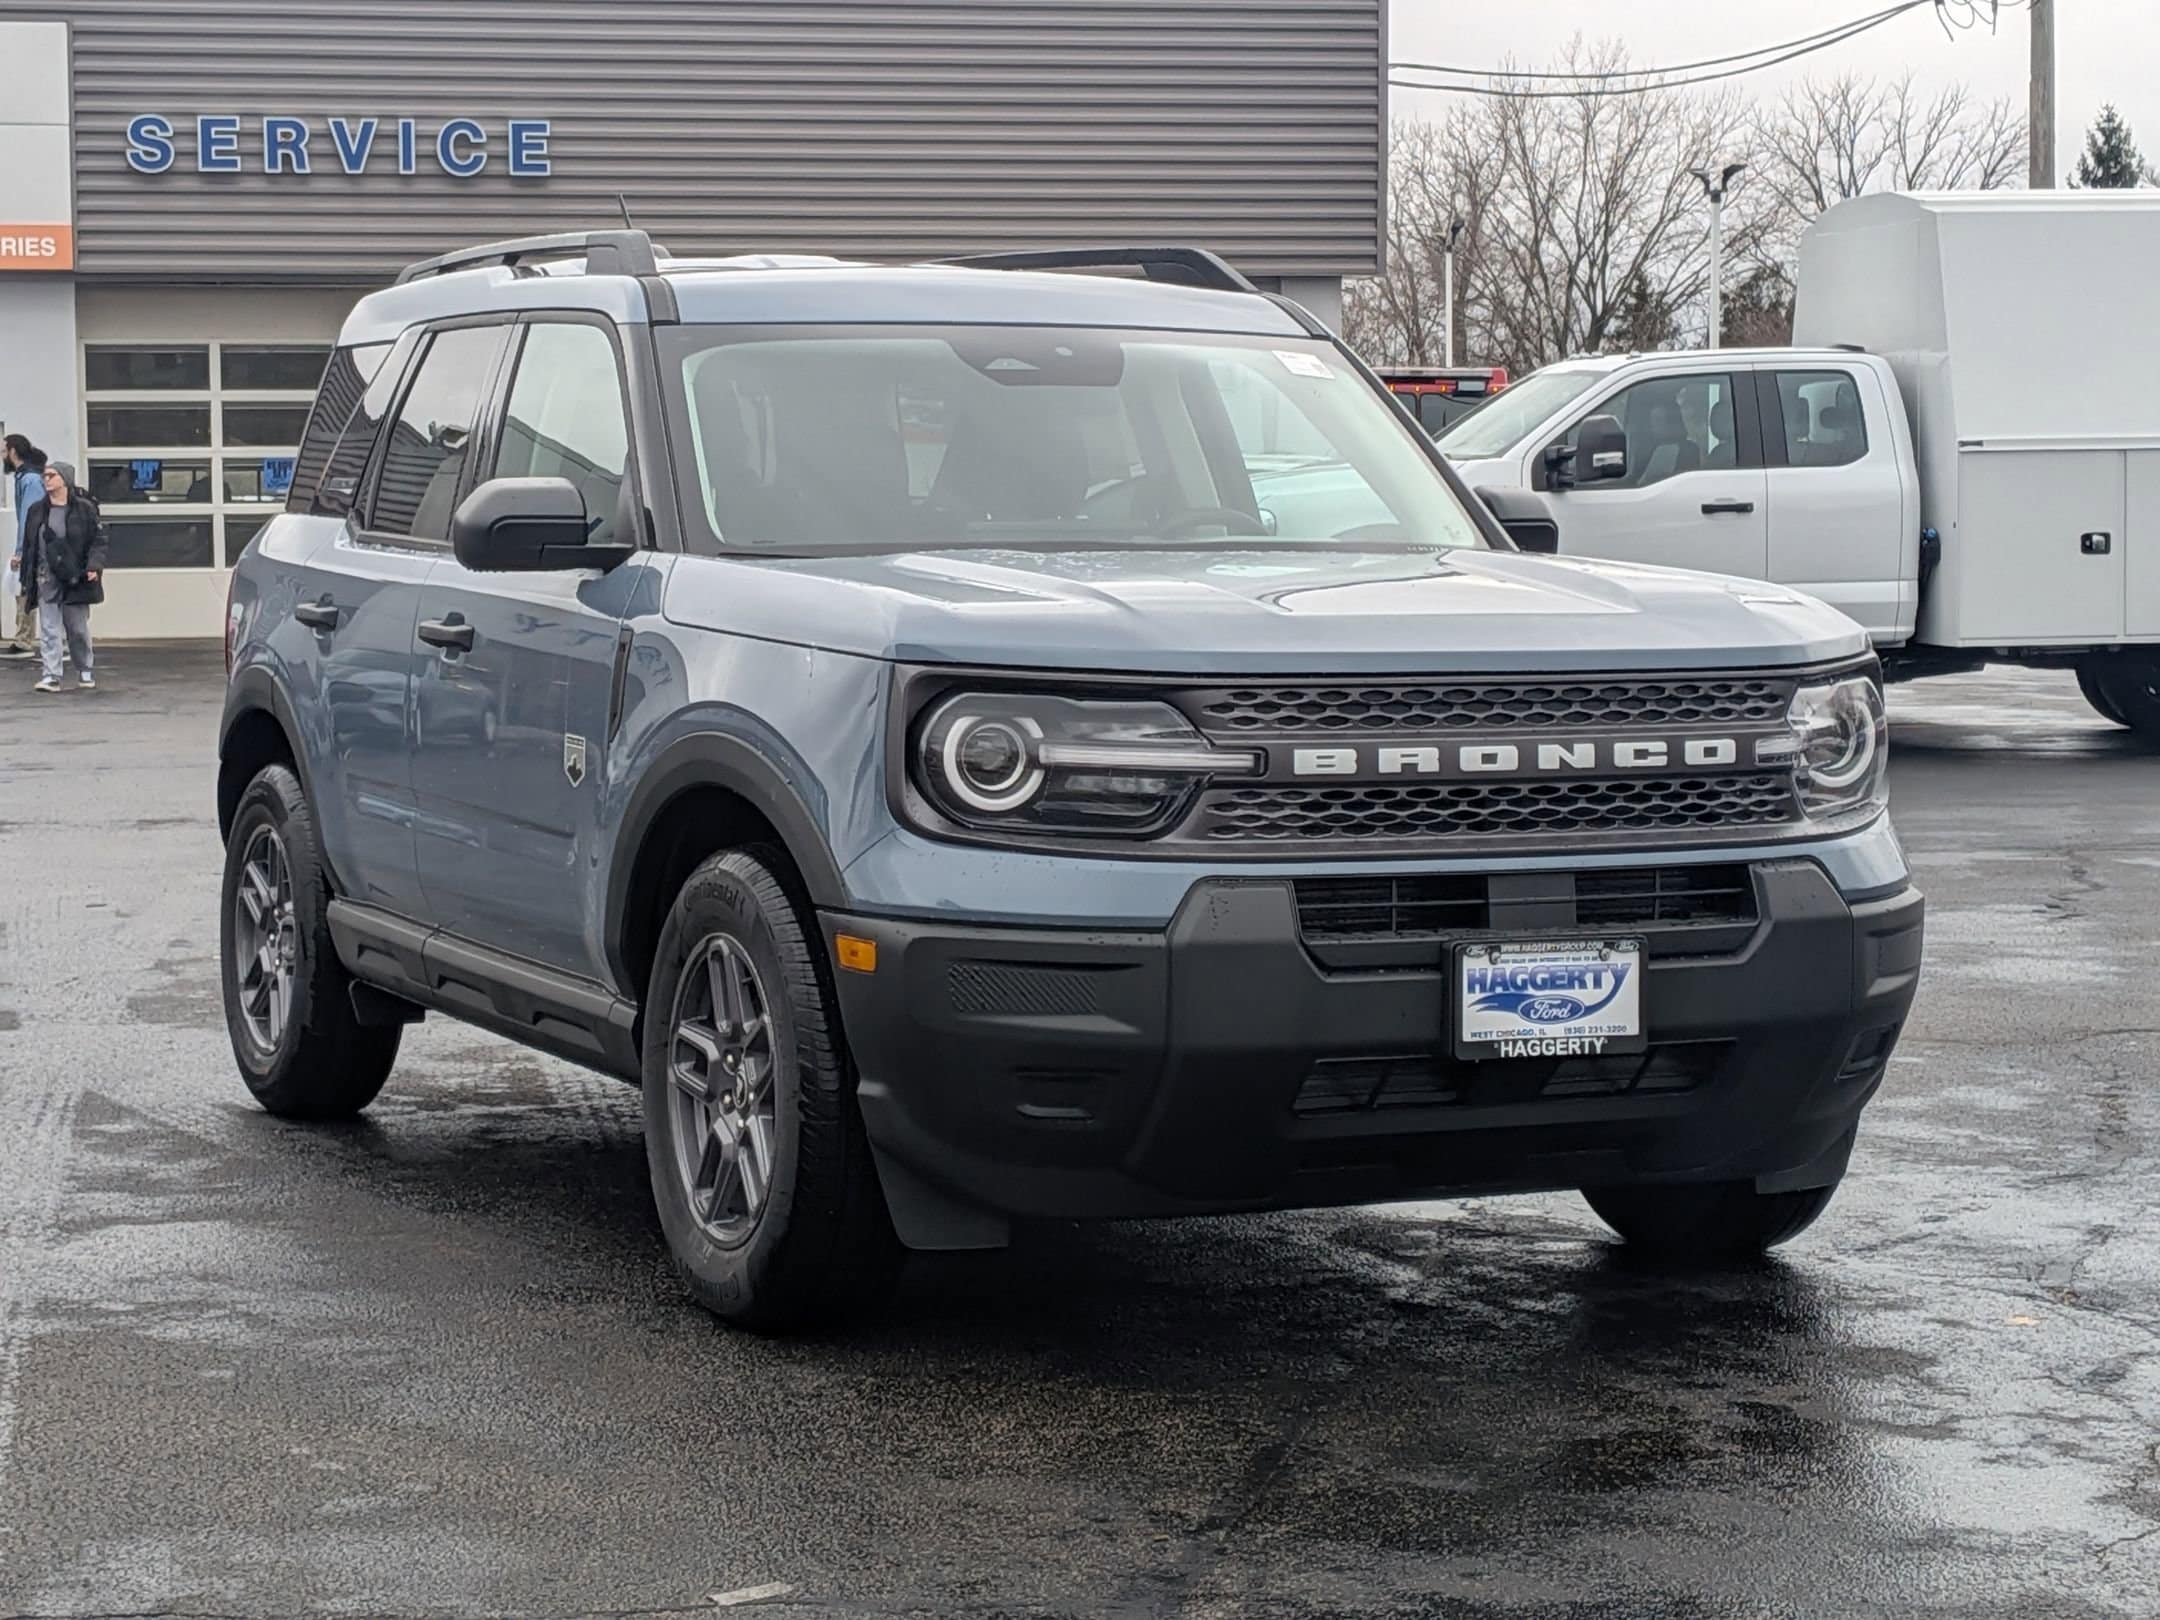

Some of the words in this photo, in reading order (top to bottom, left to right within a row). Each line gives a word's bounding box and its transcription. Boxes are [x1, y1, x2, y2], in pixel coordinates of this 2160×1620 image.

[126, 113, 552, 176] SERVICE
[1293, 738, 1736, 775] BRONCO
[1466, 963, 1632, 994] HAGGERTY
[1530, 1000, 1571, 1019] Ford
[1471, 1031, 1494, 1039] WEST
[1500, 1037, 1604, 1058] HAGGERTY
